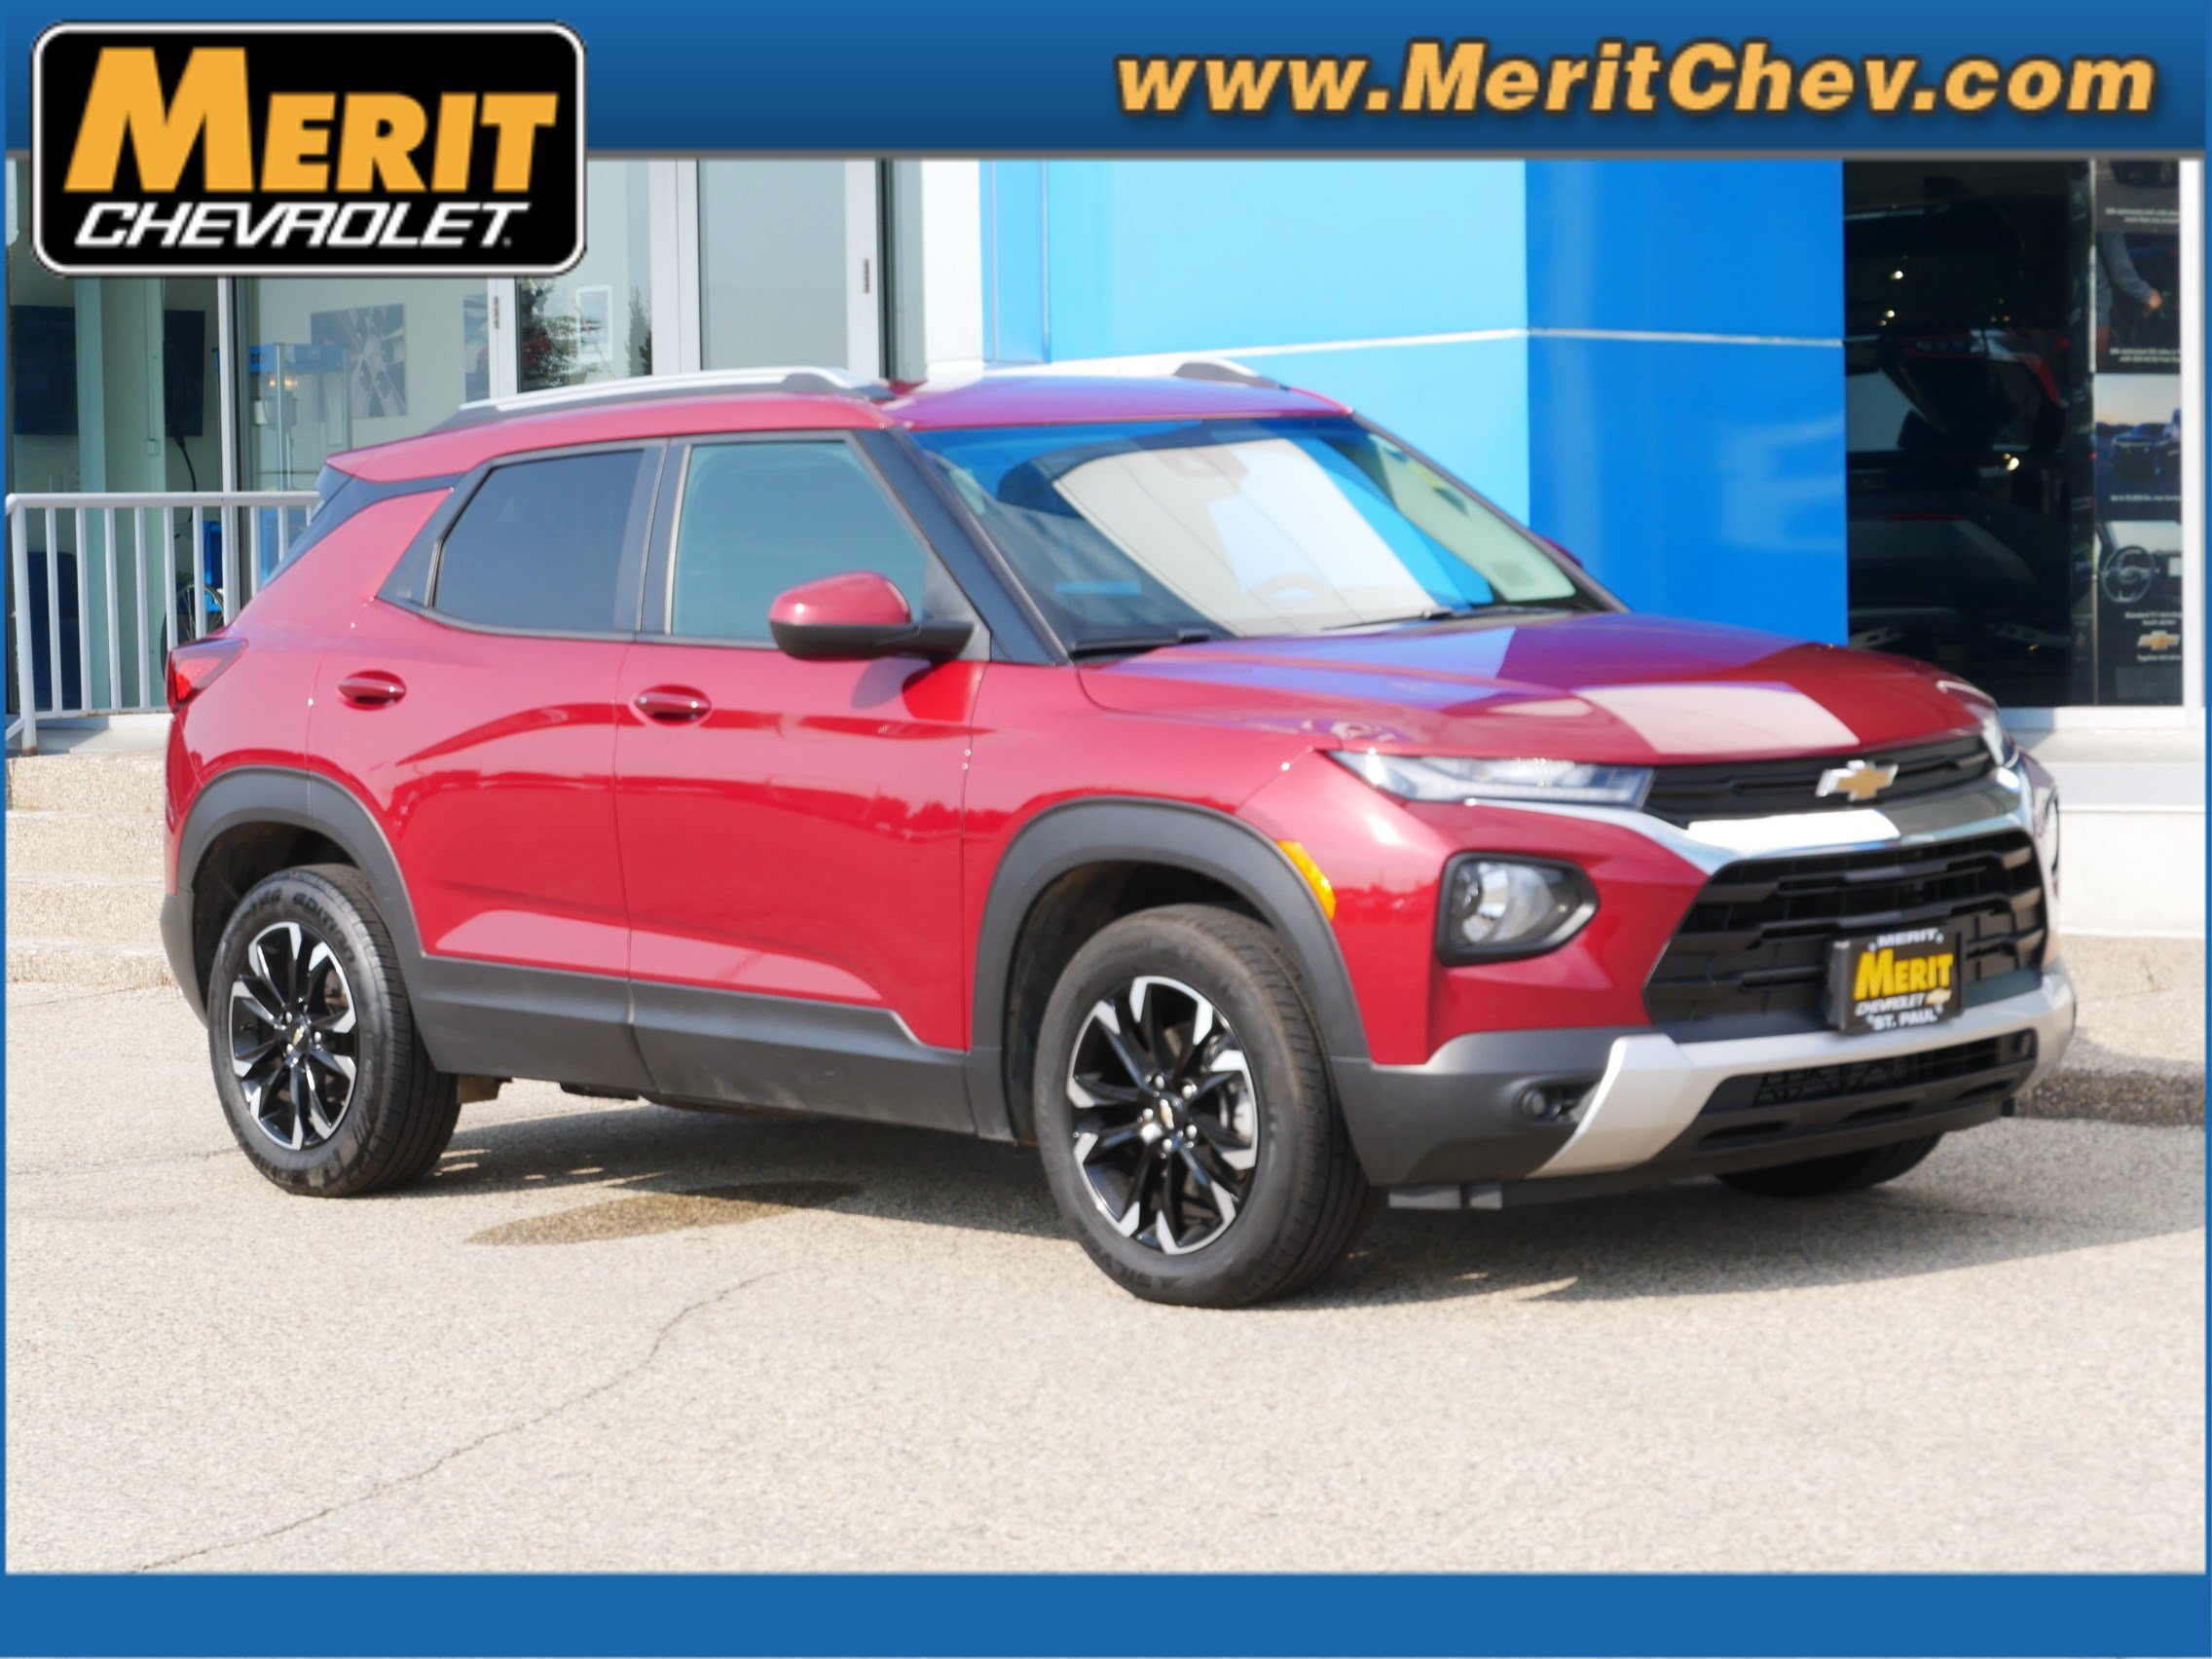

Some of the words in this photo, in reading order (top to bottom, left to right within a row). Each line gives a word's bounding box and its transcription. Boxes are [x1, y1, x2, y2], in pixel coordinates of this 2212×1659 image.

[1876, 927, 1939, 946] MERIT
[1854, 947, 1954, 1001] MERIT
[1899, 1008, 1937, 1027] PAUL
